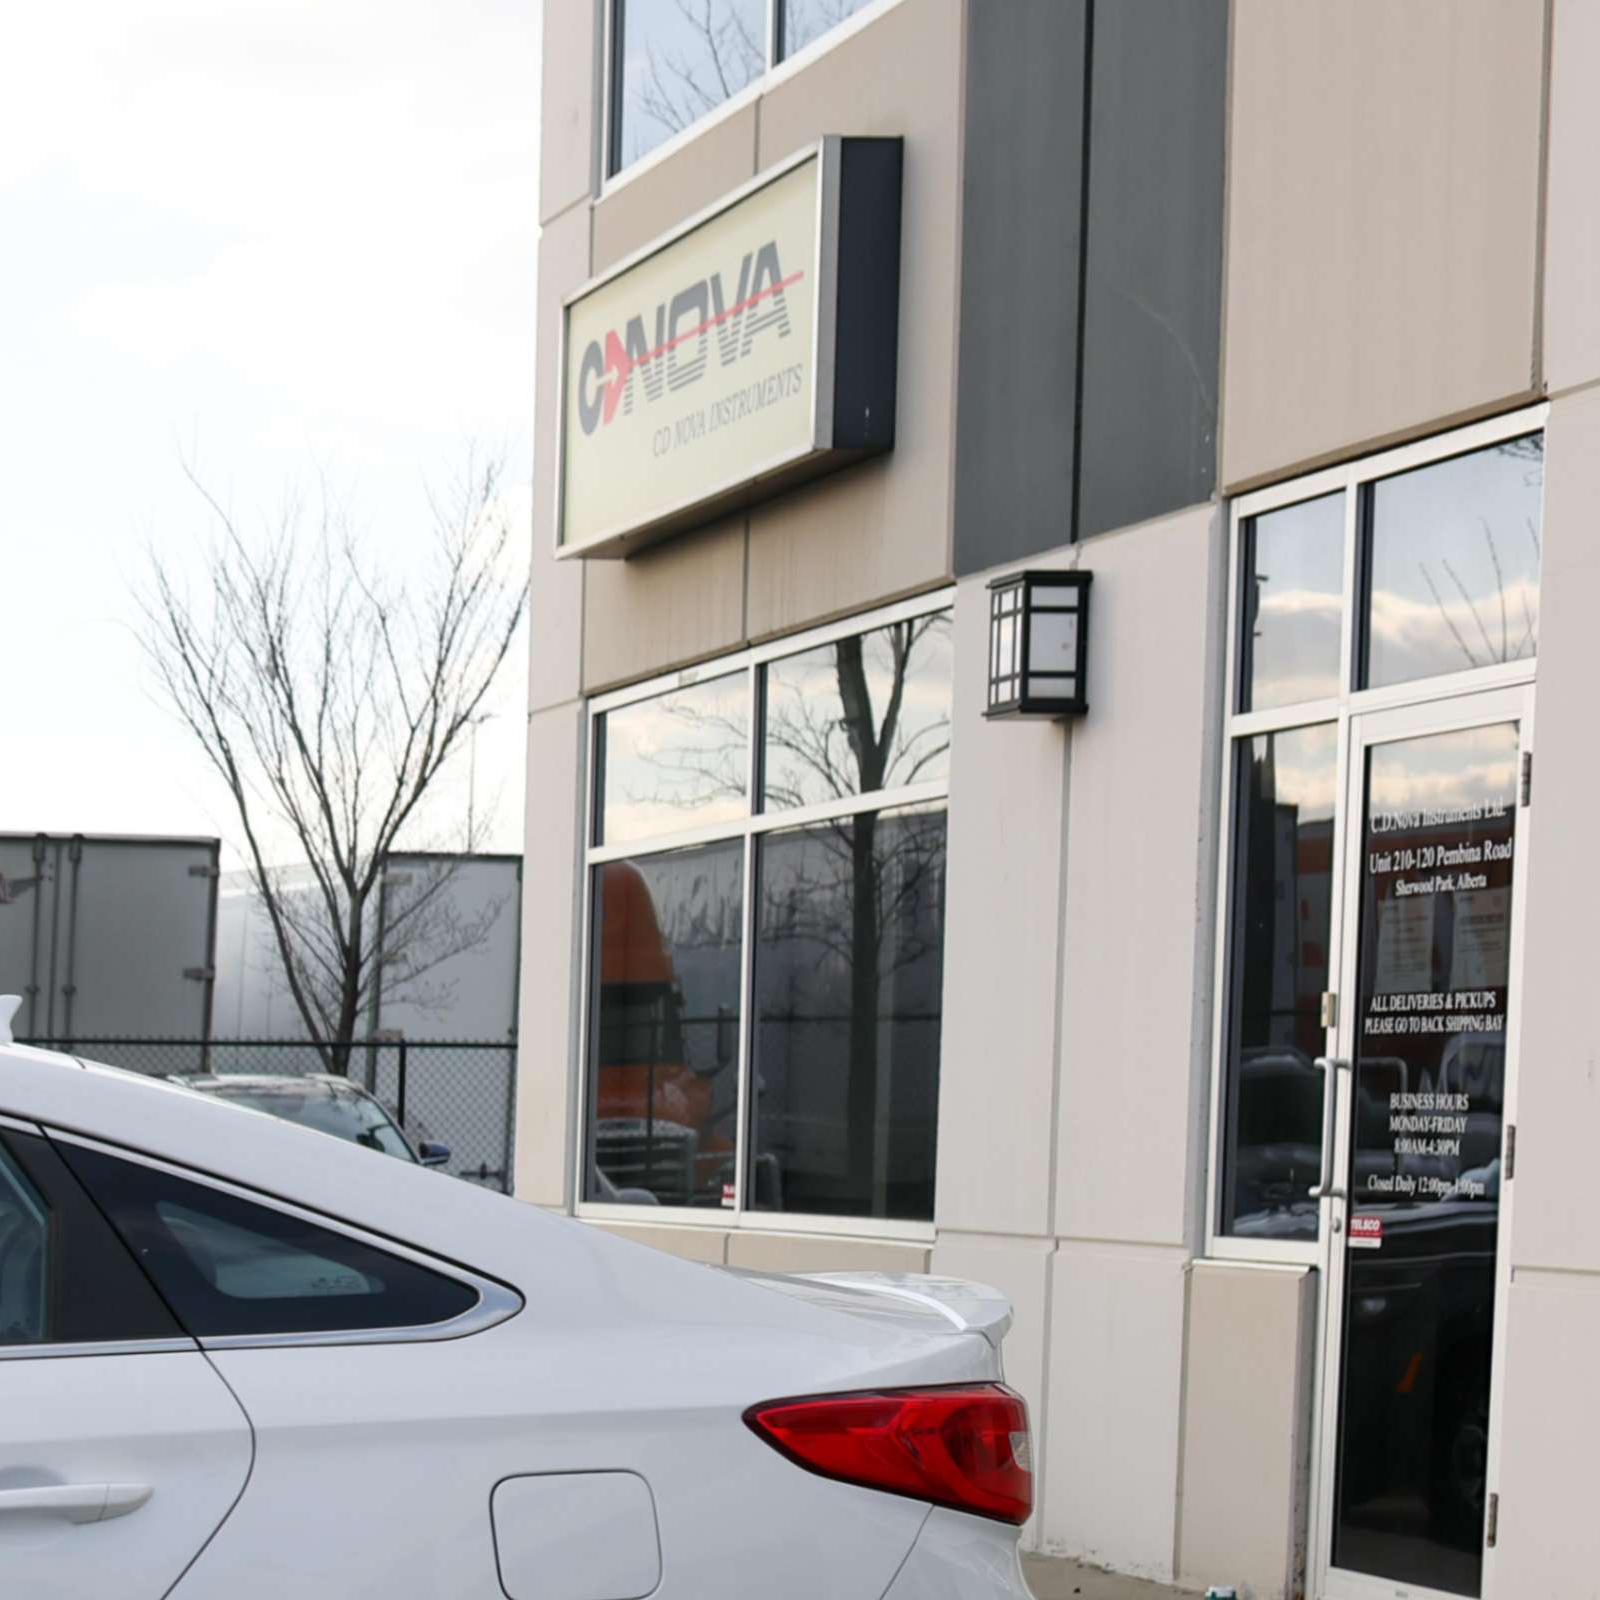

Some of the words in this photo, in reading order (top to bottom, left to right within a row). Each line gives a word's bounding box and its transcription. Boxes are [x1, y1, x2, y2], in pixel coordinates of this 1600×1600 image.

[652, 426, 672, 458] CD
[674, 408, 706, 449] NOVA
[708, 363, 804, 433] INSTRUMENTS
[1422, 803, 1482, 828] Instruments
[1369, 853, 1392, 875] Unit
[1392, 847, 1436, 872] 210-120
[1436, 841, 1482, 867] Pembina
[1483, 837, 1513, 861] Road
[1395, 877, 1435, 897] Sherwood
[1456, 872, 1487, 890] Alberta
[1369, 996, 1388, 1013] ALL
[1389, 993, 1444, 1011] DELIVERIES
[1444, 992, 1453, 1010] &
[1454, 991, 1497, 1009] PICKUPS
[1364, 1017, 1394, 1035] PLEASE
[1394, 1016, 1408, 1034] GO
[1409, 1016, 1421, 1033] TO
[1421, 1015, 1445, 1033] BACK
[1445, 1015, 1485, 1032] SHIPPING
[1485, 1014, 1505, 1032] BAY
[1389, 1092, 1435, 1110] BUSINESS
[1435, 1093, 1470, 1111] HOURS
[1389, 1115, 1468, 1134] MONDAY-FRIDAY
[1367, 1174, 1394, 1192] Closed
[1394, 1175, 1417, 1198] Daily
